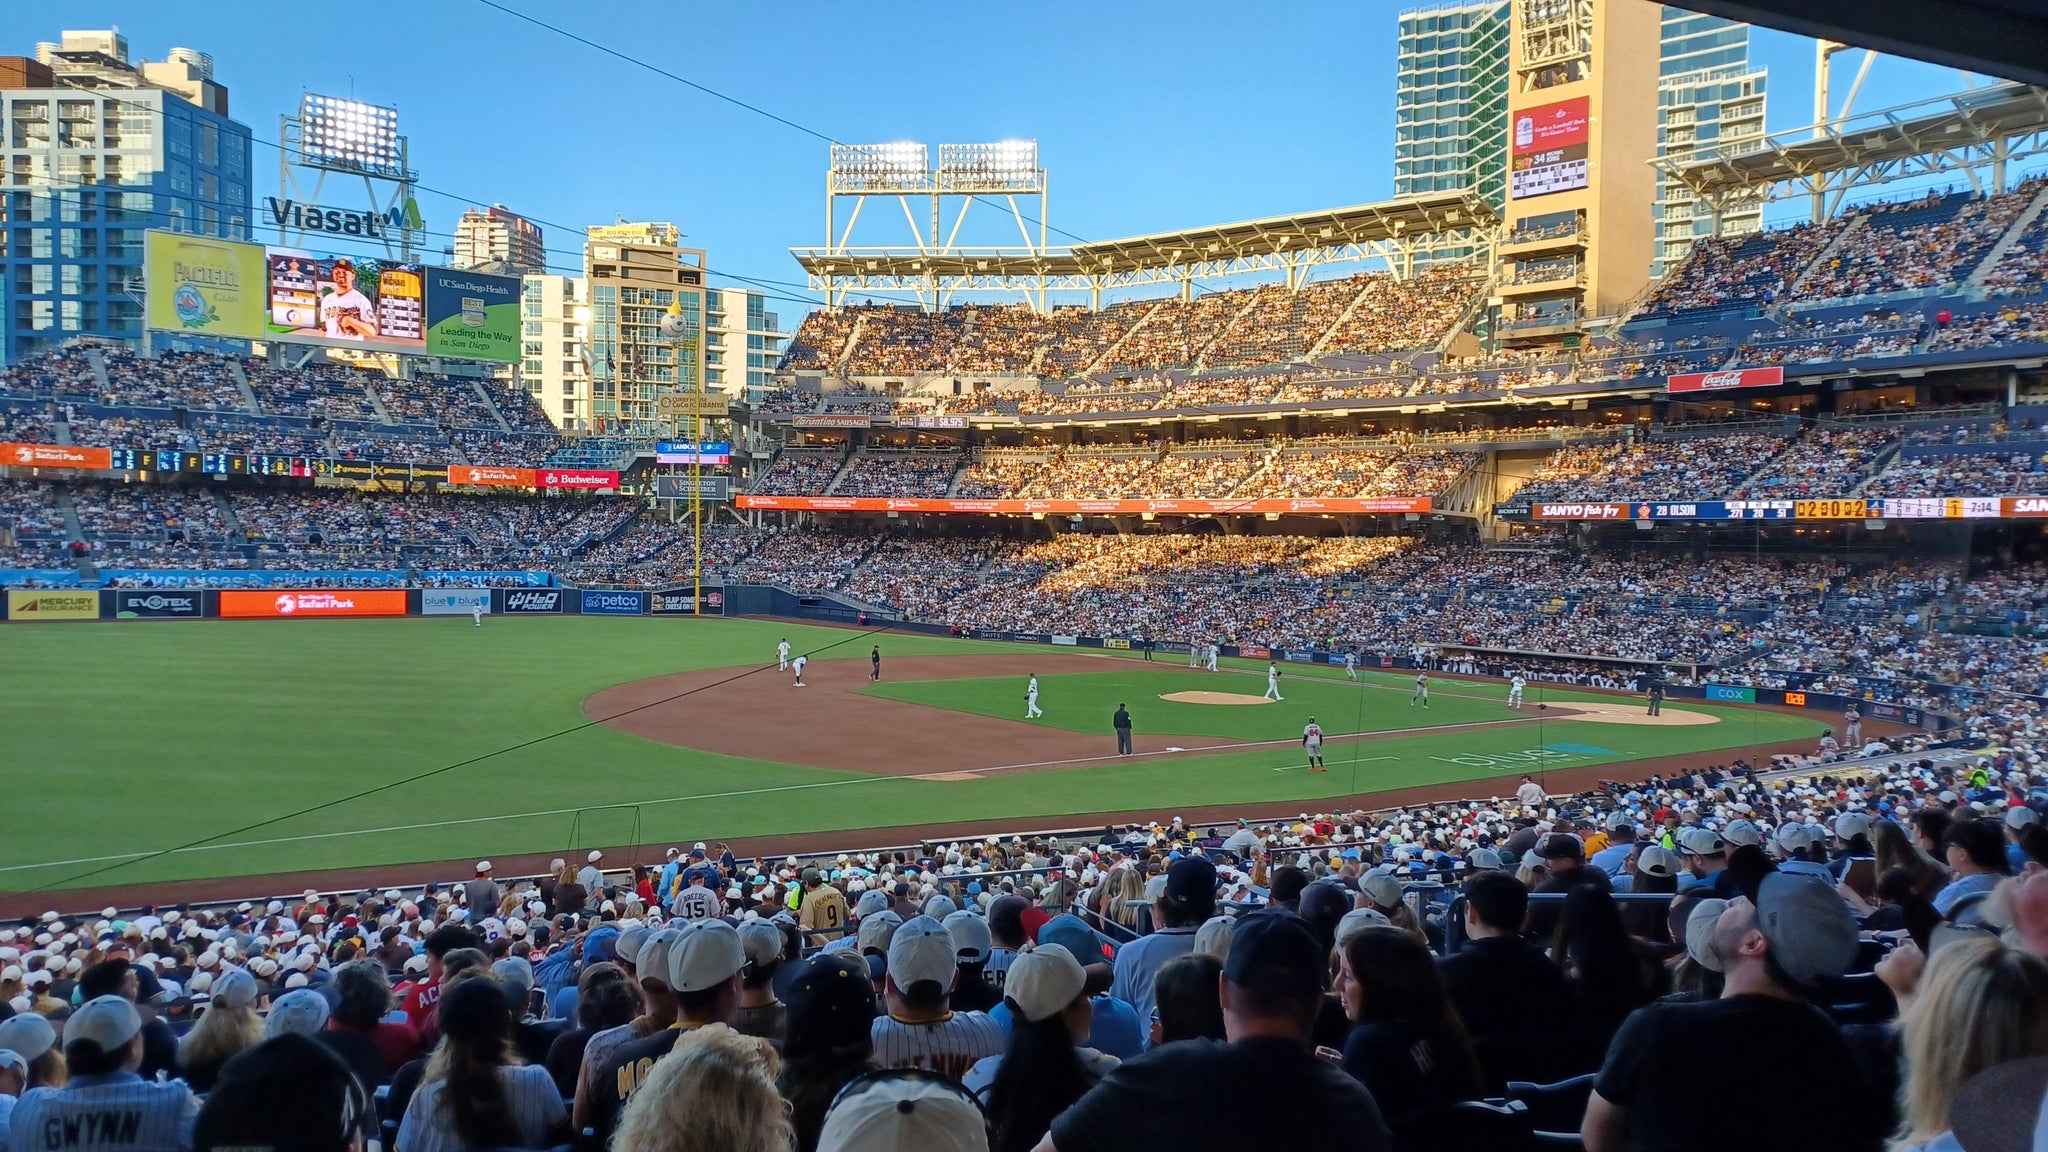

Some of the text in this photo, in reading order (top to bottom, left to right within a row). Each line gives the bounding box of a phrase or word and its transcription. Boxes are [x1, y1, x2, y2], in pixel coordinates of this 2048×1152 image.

[1534, 154, 1545, 165] 34
[269, 196, 379, 237] Viasat
[383, 279, 406, 287] MICHAEL
[439, 278, 509, 295] UC San Diego Health
[463, 298, 482, 306] BEST
[440, 326, 513, 343] Leading the Way
[440, 338, 490, 351] in San Diego
[795, 416, 835, 425] Tarantino
[35, 451, 62, 460] Safari
[126, 450, 134, 460] 3
[143, 455, 151, 466] F
[173, 452, 181, 461] 2
[189, 457, 198, 467] F
[218, 454, 226, 464] 2
[234, 459, 242, 469] F
[262, 456, 269, 466] 3
[276, 461, 284, 471] 8
[305, 458, 310, 467] 1
[318, 463, 325, 472] 3
[126, 460, 134, 469] 5
[174, 461, 180, 471] 1
[218, 464, 226, 473] 4
[261, 465, 269, 475] 4
[482, 472, 502, 480] Safari
[561, 474, 609, 485] Budweiser
[1542, 505, 1583, 516] SANYO
[1583, 505, 1602, 518] fish
[1603, 504, 1620, 518] fry
[1656, 504, 1696, 516] 28 OLSON
[1728, 508, 1786, 518] .271 20 51
[1808, 501, 1816, 517] 2
[1831, 501, 1840, 516] 0
[1855, 500, 1863, 516] 2
[1971, 502, 1992, 512] 7:14
[39, 597, 93, 605] MERCURY
[127, 595, 193, 609] EVOTEK
[298, 599, 354, 609] Safari Park
[424, 596, 446, 606] blue
[458, 596, 480, 606] blue
[524, 592, 559, 604] H2O
[601, 594, 638, 607] petco
[665, 596, 679, 604] SLAP
[680, 596, 695, 604] SOME
[1718, 688, 1743, 699] COX
[1428, 749, 1569, 767] blue
[685, 901, 705, 919] 15
[827, 904, 838, 927] 9
[617, 1055, 656, 1100] MO
[44, 1110, 142, 1150] GWYNN
